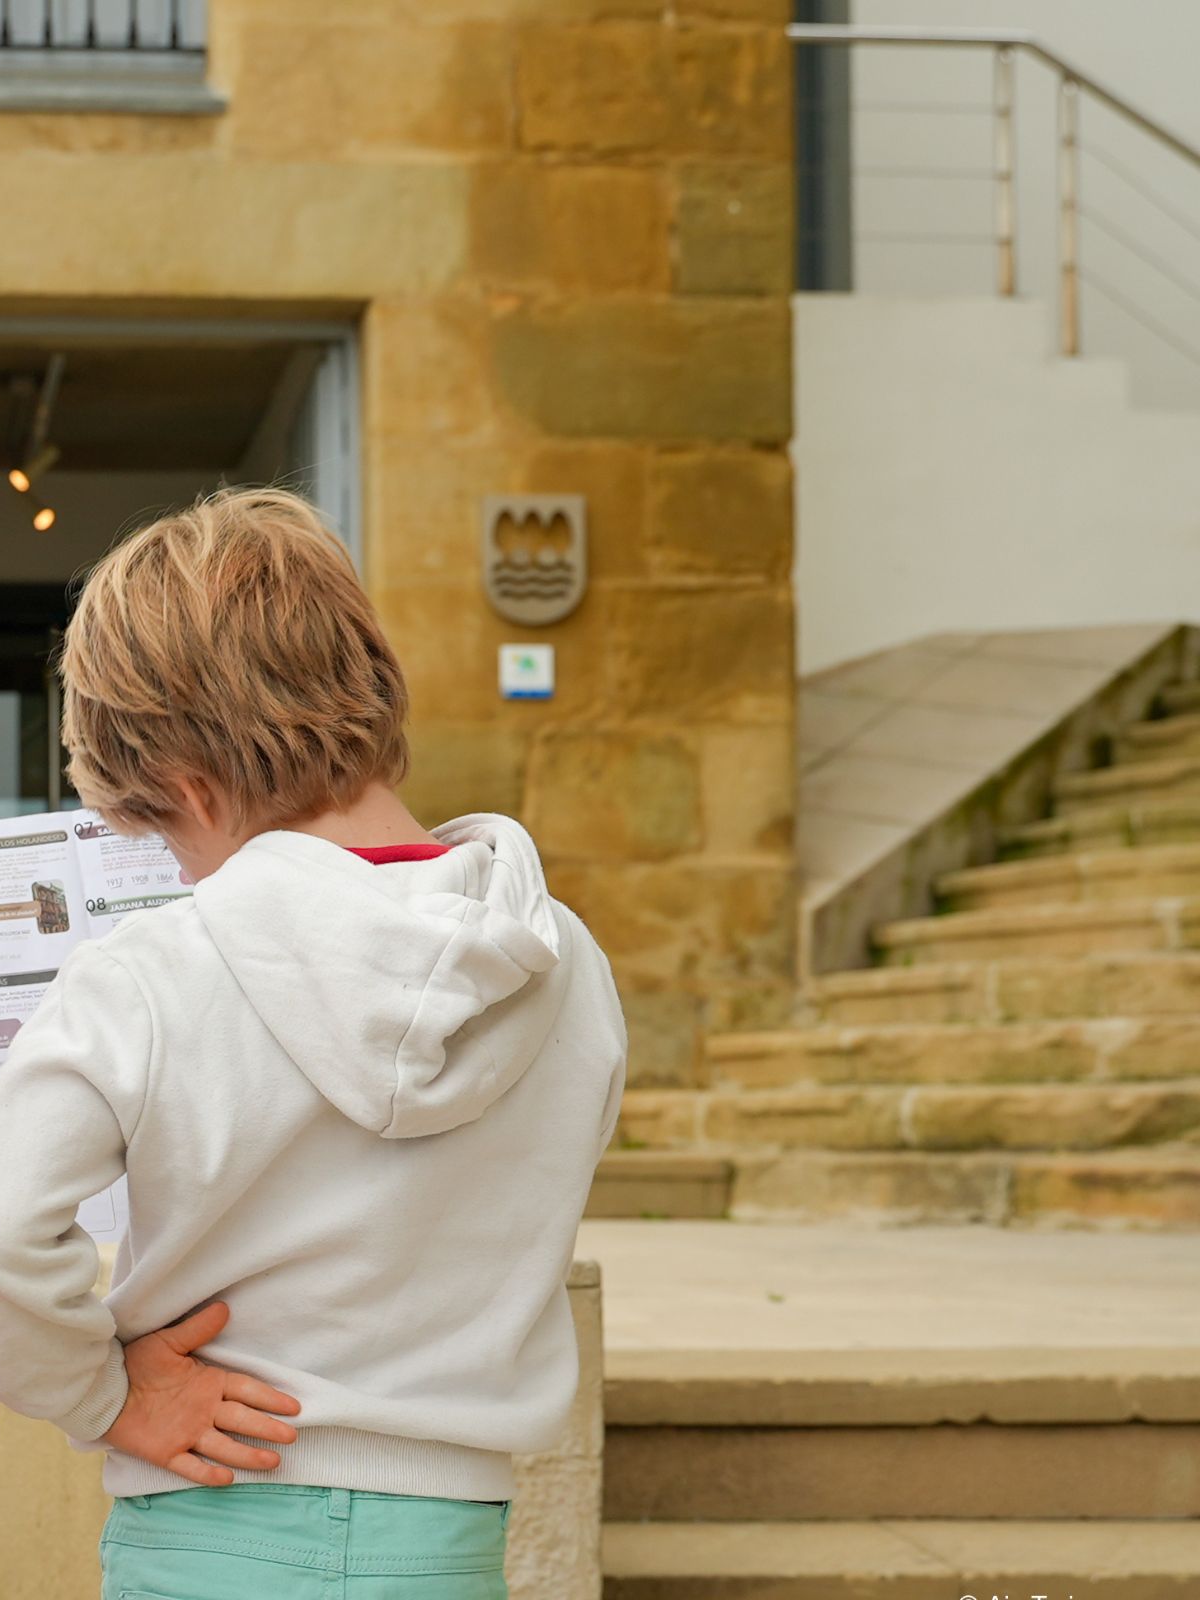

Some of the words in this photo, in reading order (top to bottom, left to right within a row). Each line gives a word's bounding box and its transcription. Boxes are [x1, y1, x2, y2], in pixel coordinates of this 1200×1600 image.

[74, 821, 93, 836] 07
[0, 838, 16, 848] LOS
[16, 833, 66, 846] HOLANDESES
[86, 897, 106, 913] 08
[110, 900, 145, 913] JARANA
